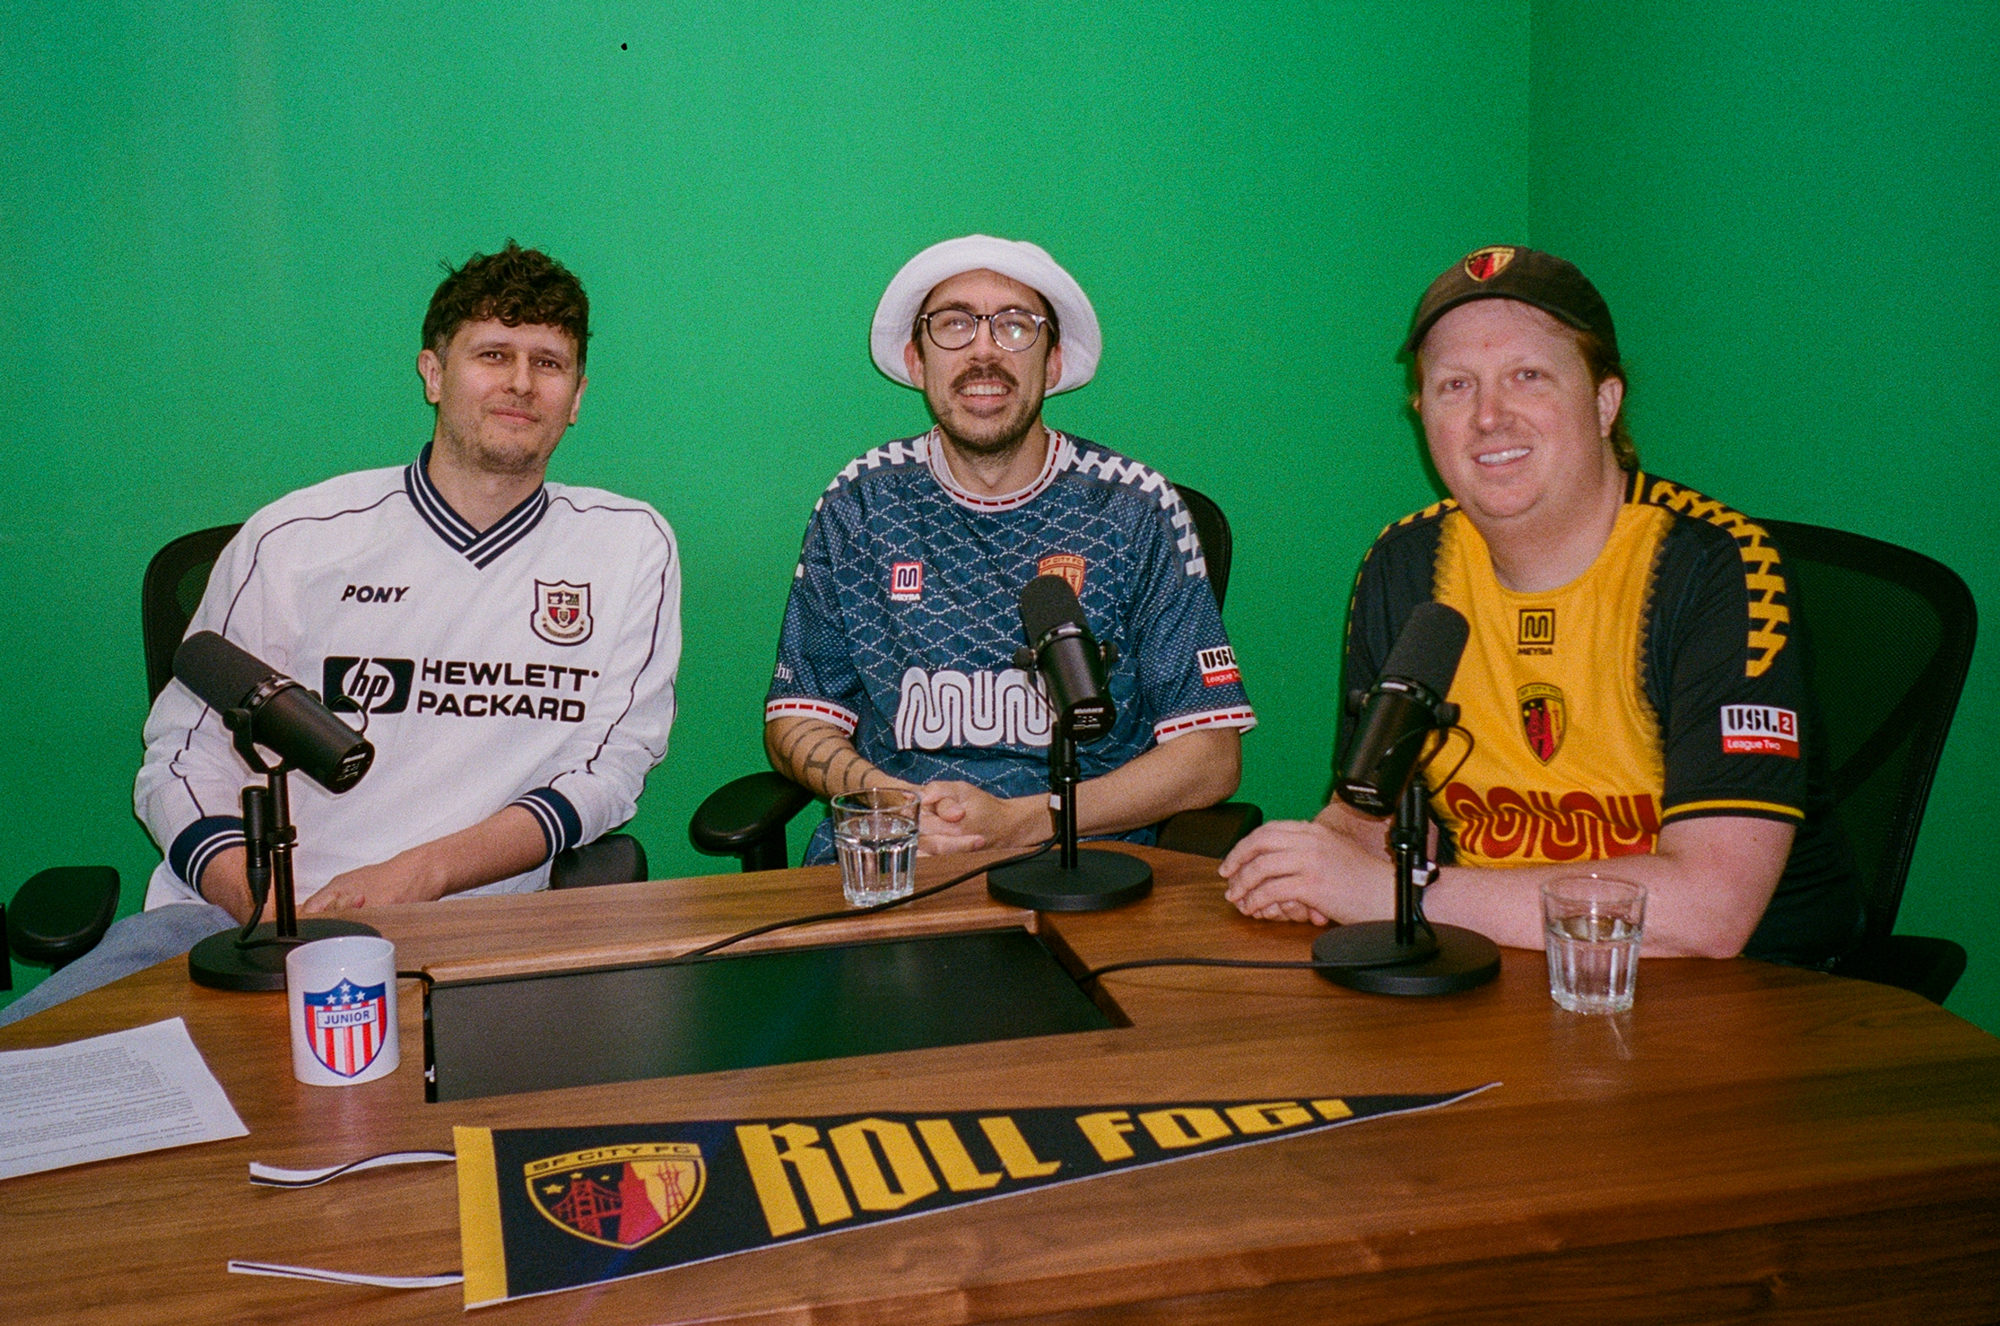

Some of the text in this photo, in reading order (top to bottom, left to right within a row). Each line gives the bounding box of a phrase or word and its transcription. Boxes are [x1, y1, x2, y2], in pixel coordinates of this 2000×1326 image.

[341, 585, 410, 603] PONY
[421, 657, 590, 692] HEWLETT
[1206, 674, 1232, 684] League
[417, 691, 586, 723] PACKARD
[1782, 716, 1791, 731] 2
[1727, 739, 1781, 751] League Two
[324, 1010, 370, 1025] JUNIOR
[533, 1146, 691, 1171] SF CITY FC
[735, 1117, 1062, 1238] ROLL
